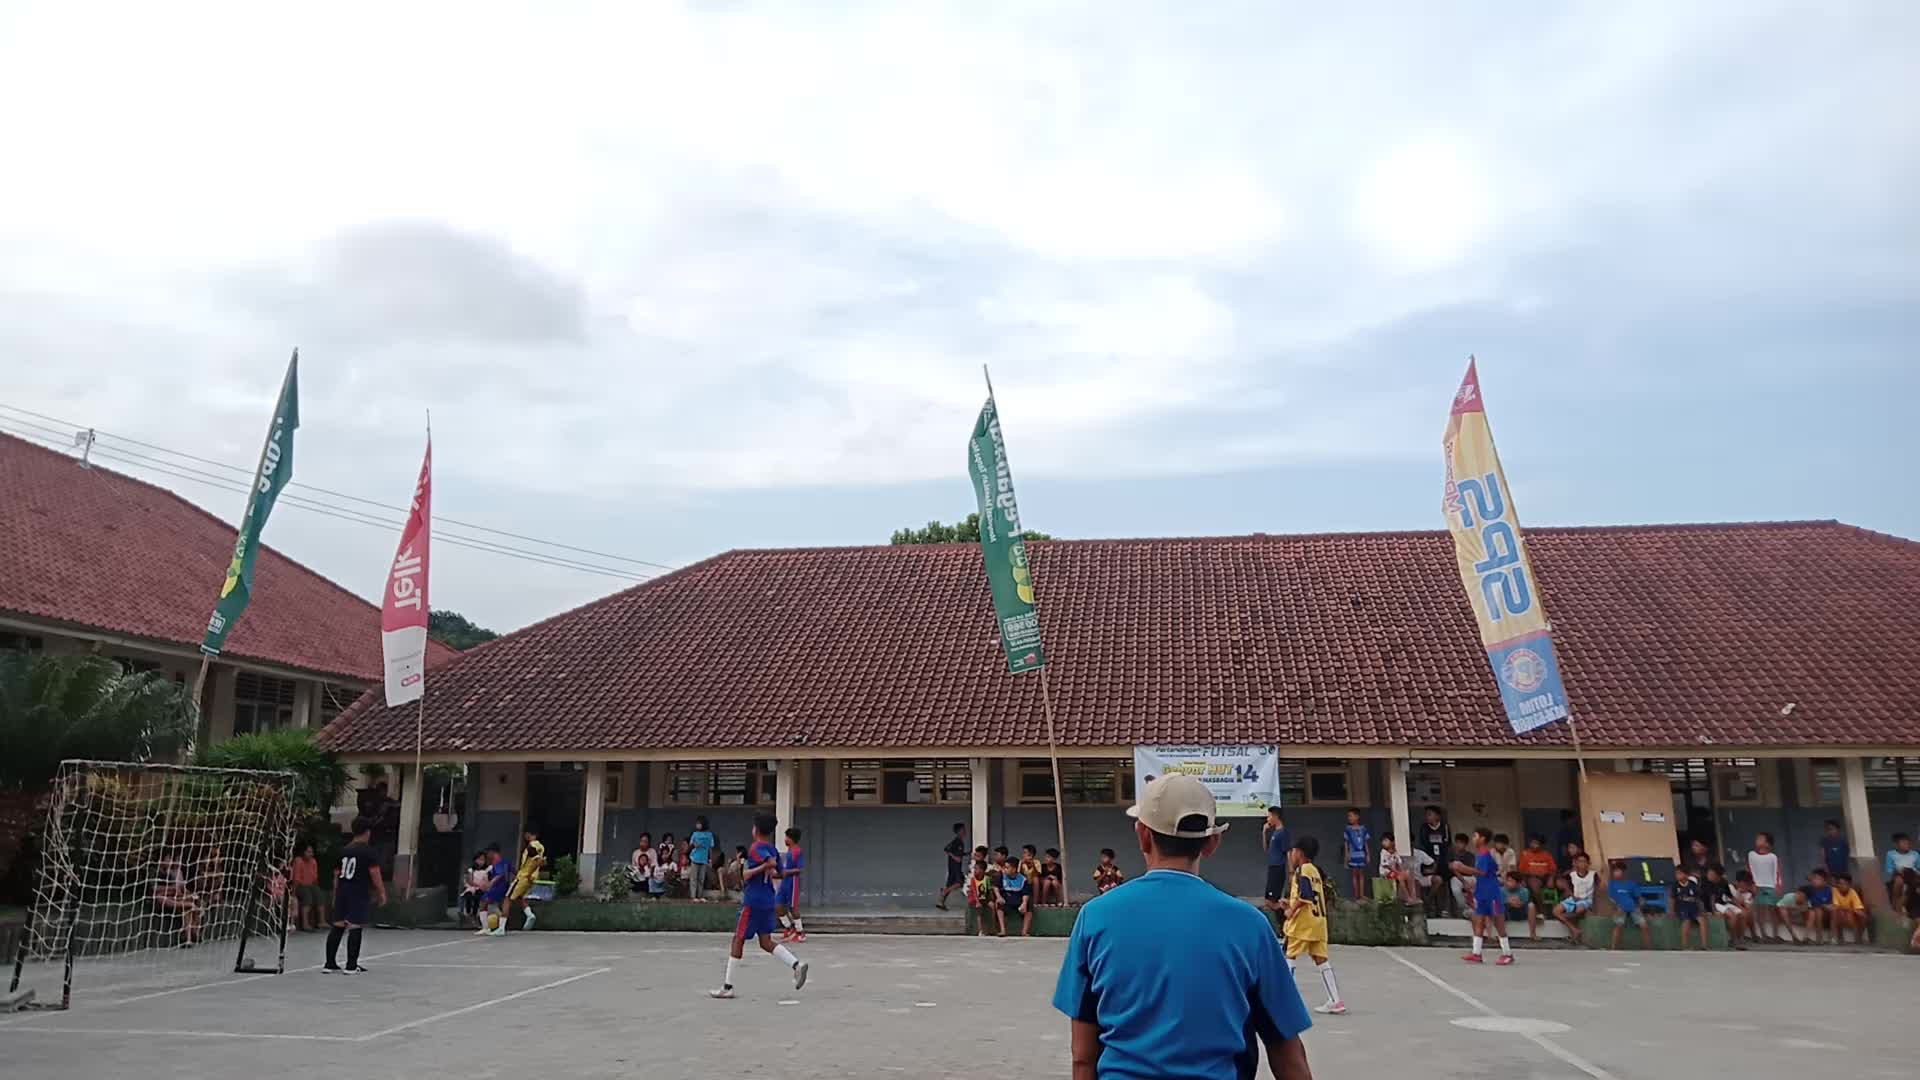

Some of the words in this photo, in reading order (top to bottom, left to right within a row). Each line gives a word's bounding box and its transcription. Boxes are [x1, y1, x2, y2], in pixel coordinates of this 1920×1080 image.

[1202, 747, 1250, 757] FUTSAL
[1235, 764, 1259, 783] 14
[339, 856, 357, 880] 10
